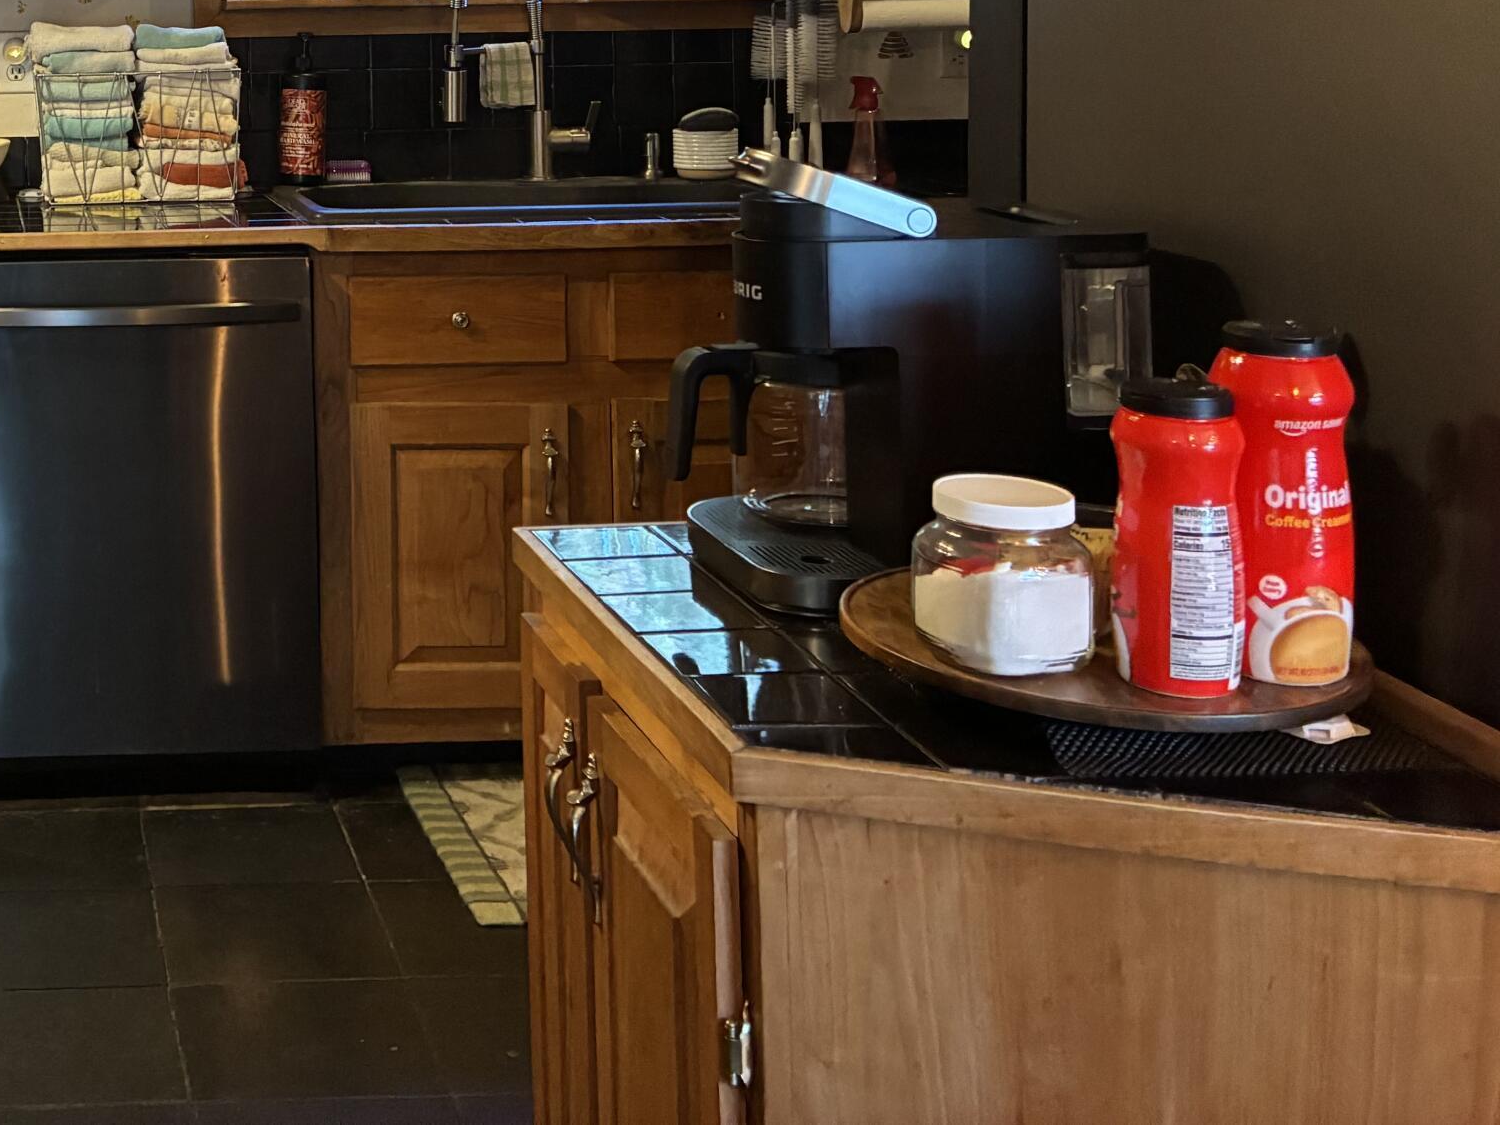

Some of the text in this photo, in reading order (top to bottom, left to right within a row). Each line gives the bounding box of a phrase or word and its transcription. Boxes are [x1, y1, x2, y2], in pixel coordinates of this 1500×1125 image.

[1274, 419, 1322, 431] amazon
[1264, 481, 1350, 515] Original
[1265, 513, 1310, 528] Coffee
